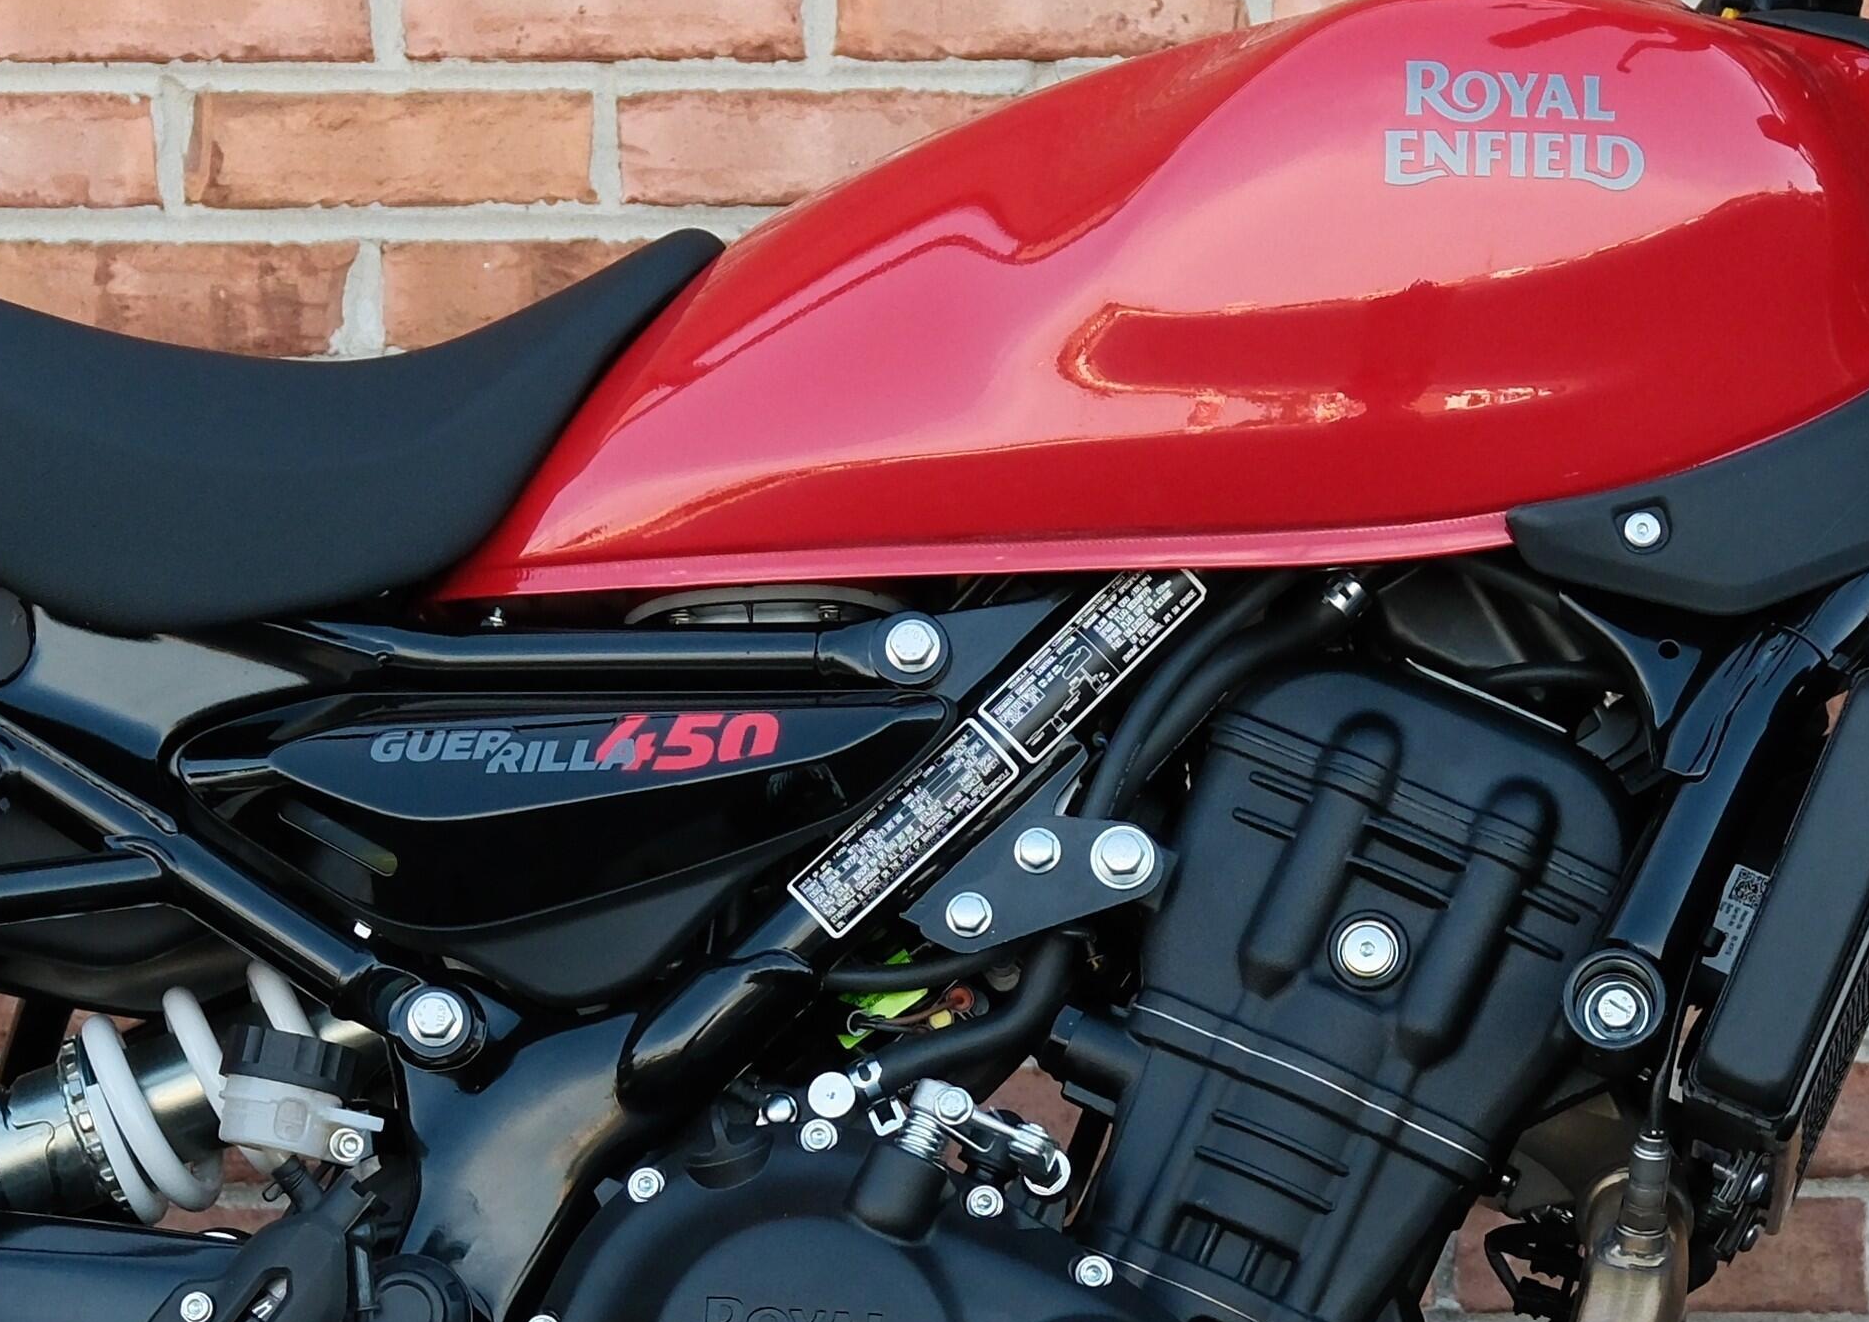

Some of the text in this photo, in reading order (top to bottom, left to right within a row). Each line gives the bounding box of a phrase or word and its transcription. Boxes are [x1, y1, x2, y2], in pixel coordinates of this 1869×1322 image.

[1404, 59, 1617, 123] ROYAL
[1384, 129, 1646, 192] ENFIELD
[369, 712, 781, 775] GUERRILLA 450
